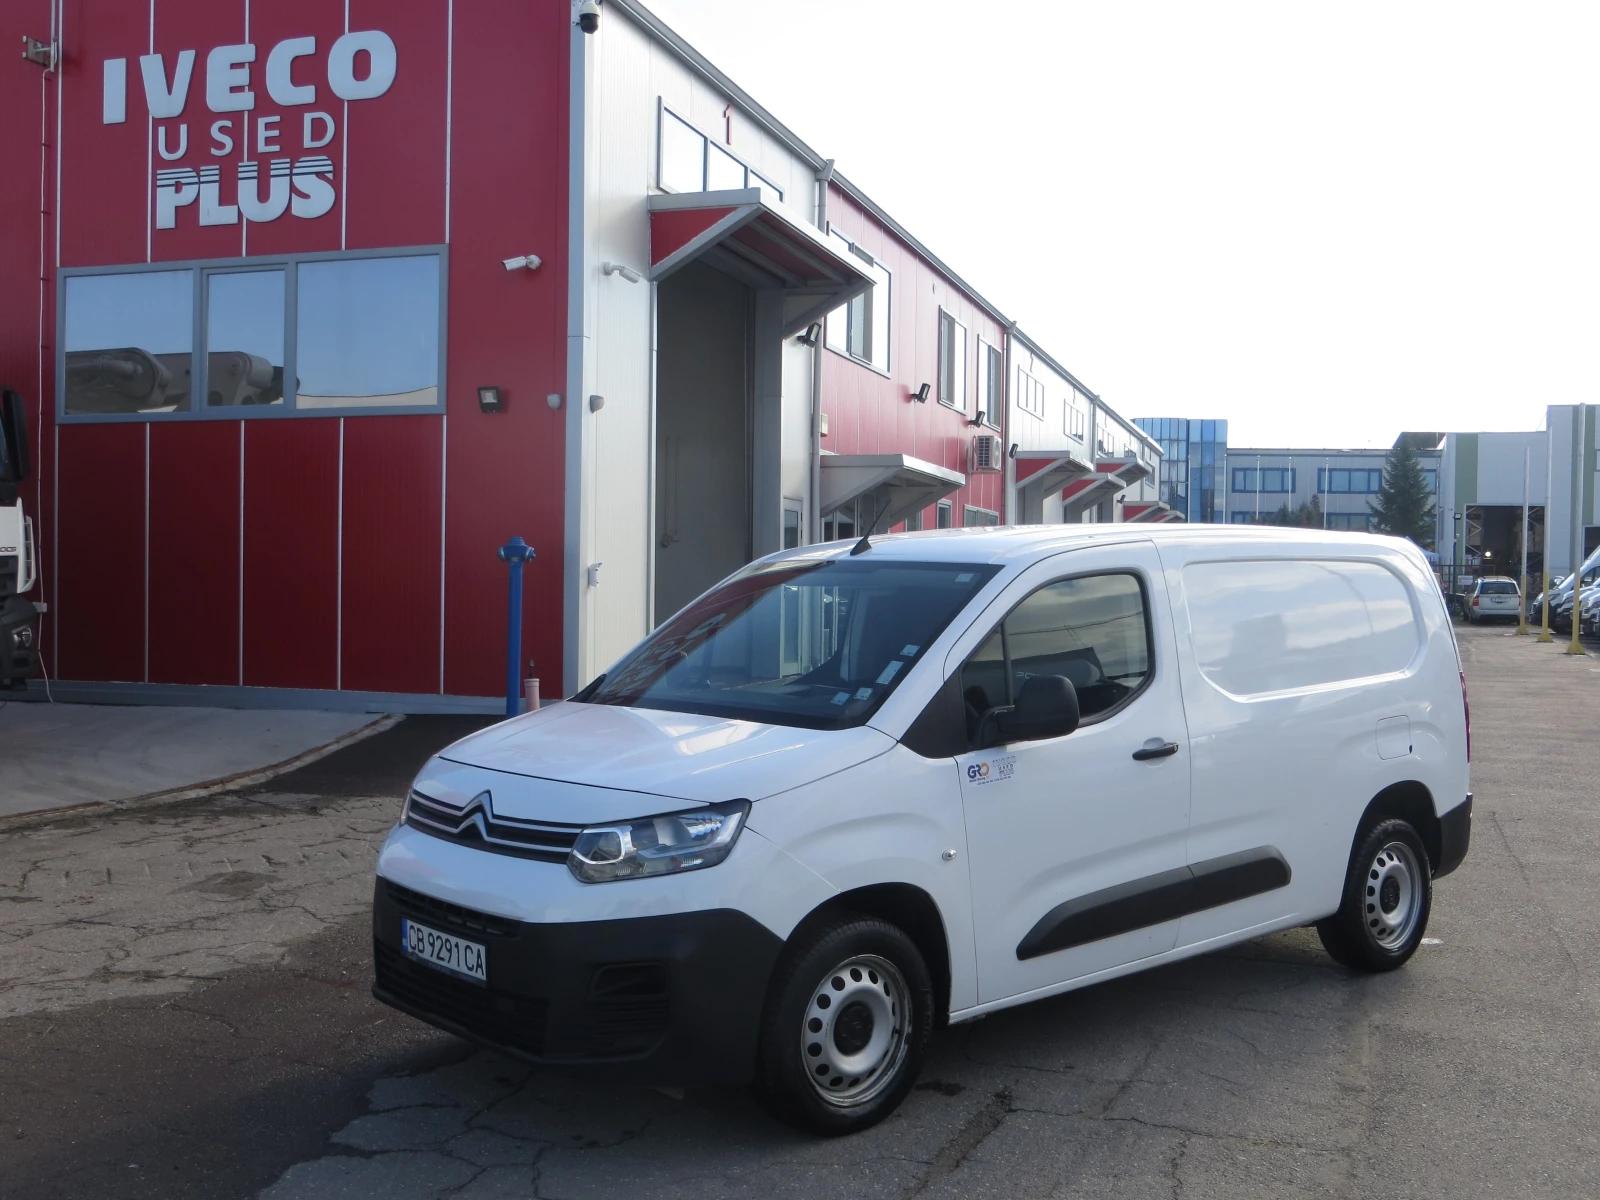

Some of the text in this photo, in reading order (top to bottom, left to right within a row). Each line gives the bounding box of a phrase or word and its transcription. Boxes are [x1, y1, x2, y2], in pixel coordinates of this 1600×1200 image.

[102, 30, 397, 125] IVECO
[157, 112, 336, 161] USED
[723, 103, 732, 145] 1
[156, 155, 336, 230] PLUS
[409, 924, 425, 954] CB
[427, 932, 460, 968] 9291
[464, 944, 485, 976] CA
